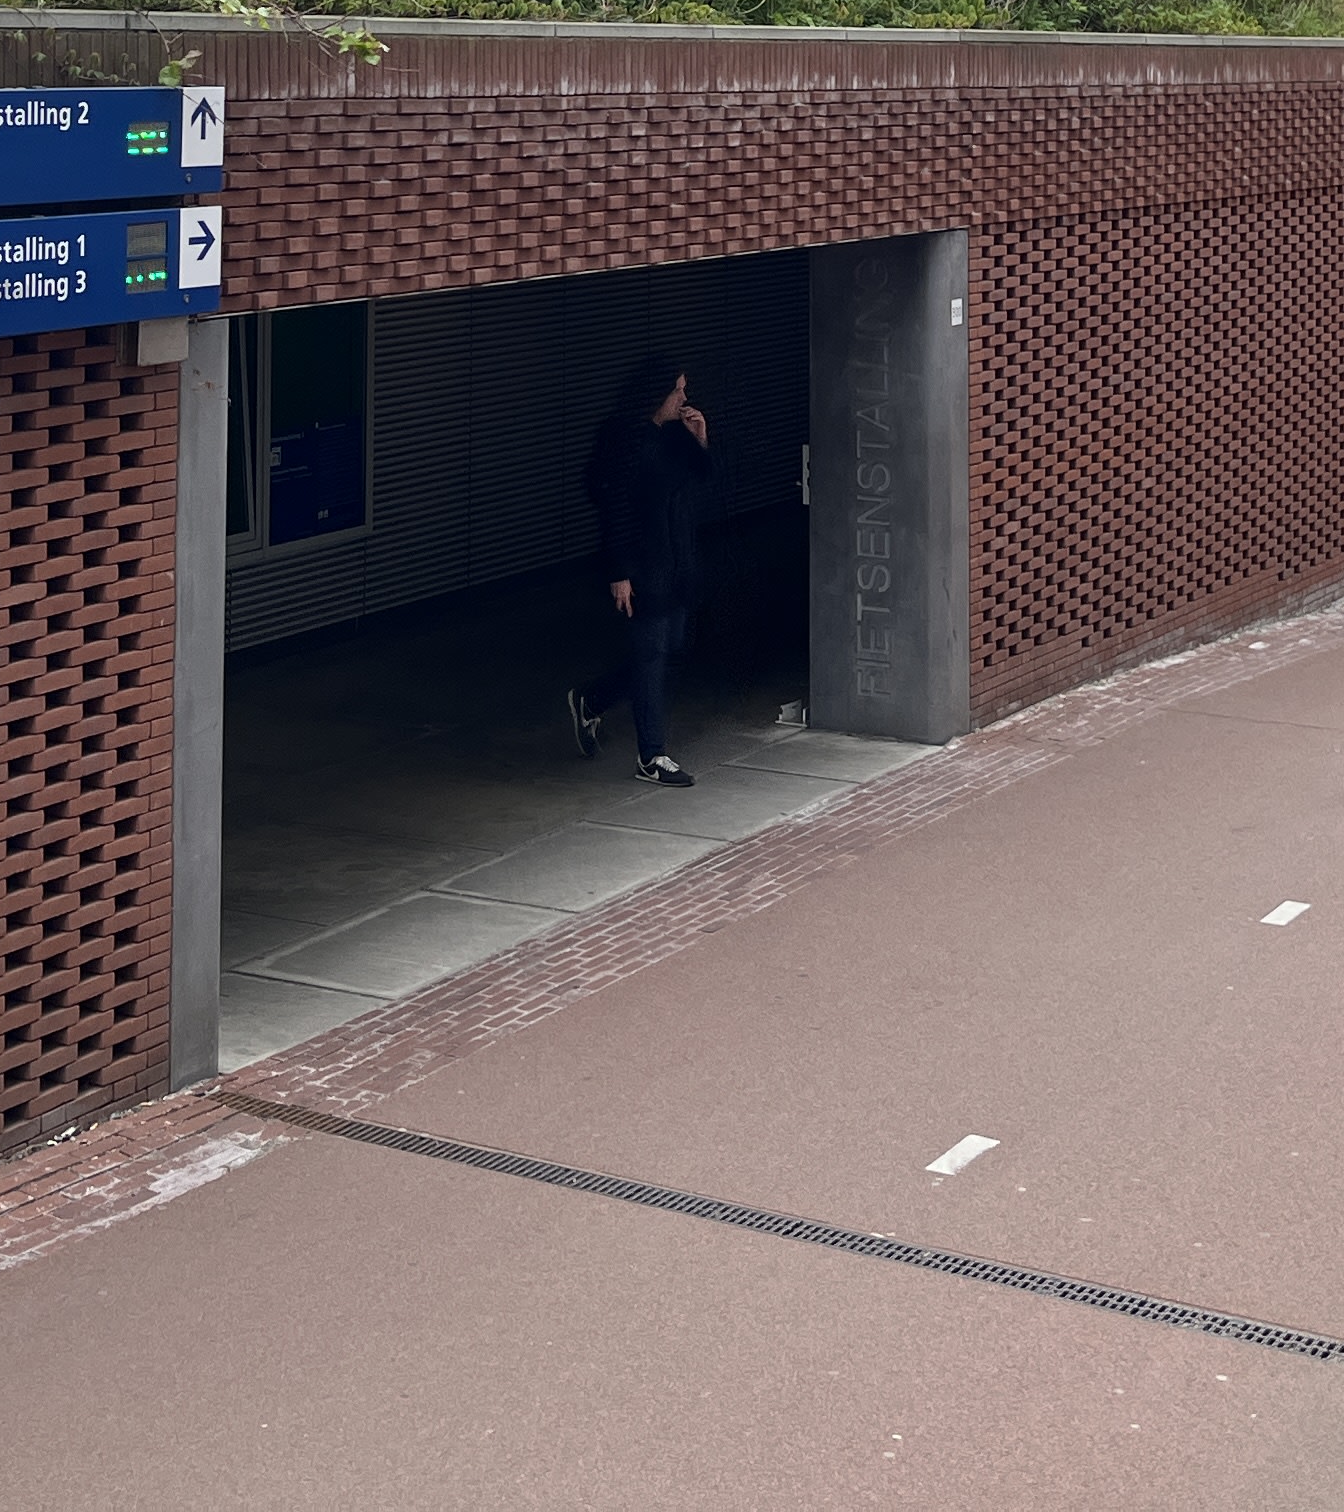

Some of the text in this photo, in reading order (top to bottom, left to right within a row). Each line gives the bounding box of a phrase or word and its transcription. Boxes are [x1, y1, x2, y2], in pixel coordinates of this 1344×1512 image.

[76, 101, 90, 125] 2
[76, 235, 87, 257] 1
[75, 271, 88, 294] 3
[854, 257, 893, 700] FIETSENSTALLING
